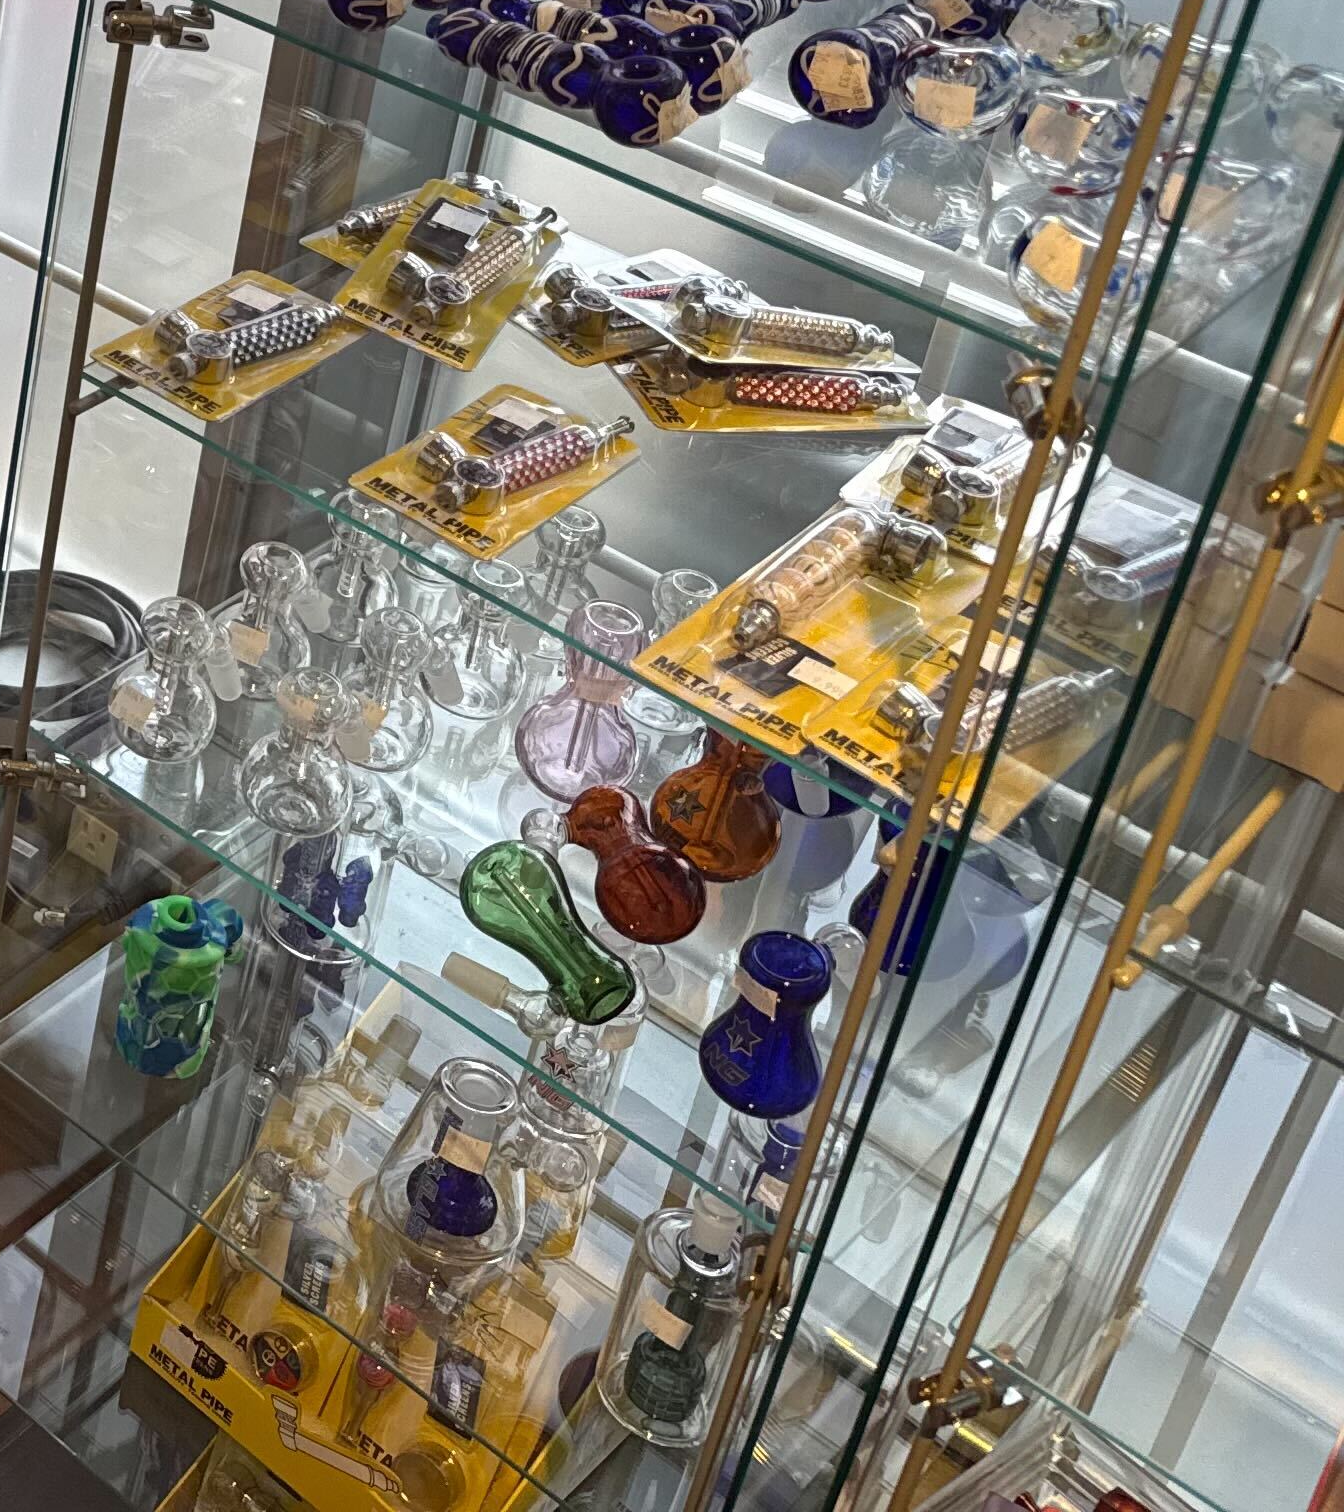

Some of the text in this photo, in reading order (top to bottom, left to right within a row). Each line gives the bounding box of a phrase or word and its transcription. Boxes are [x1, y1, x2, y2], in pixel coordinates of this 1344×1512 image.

[346, 298, 415, 338] METAL
[420, 331, 471, 363] PIPE
[108, 349, 223, 414] METAL PIPE
[367, 476, 438, 521] METAL
[444, 516, 497, 553] PIPE
[651, 654, 802, 740] METAL PIPE
[301, 1262, 315, 1297] SILVER
[312, 1261, 327, 1308] SCREENS
[149, 1343, 197, 1393] METAL
[200, 1389, 235, 1424] PIPE
